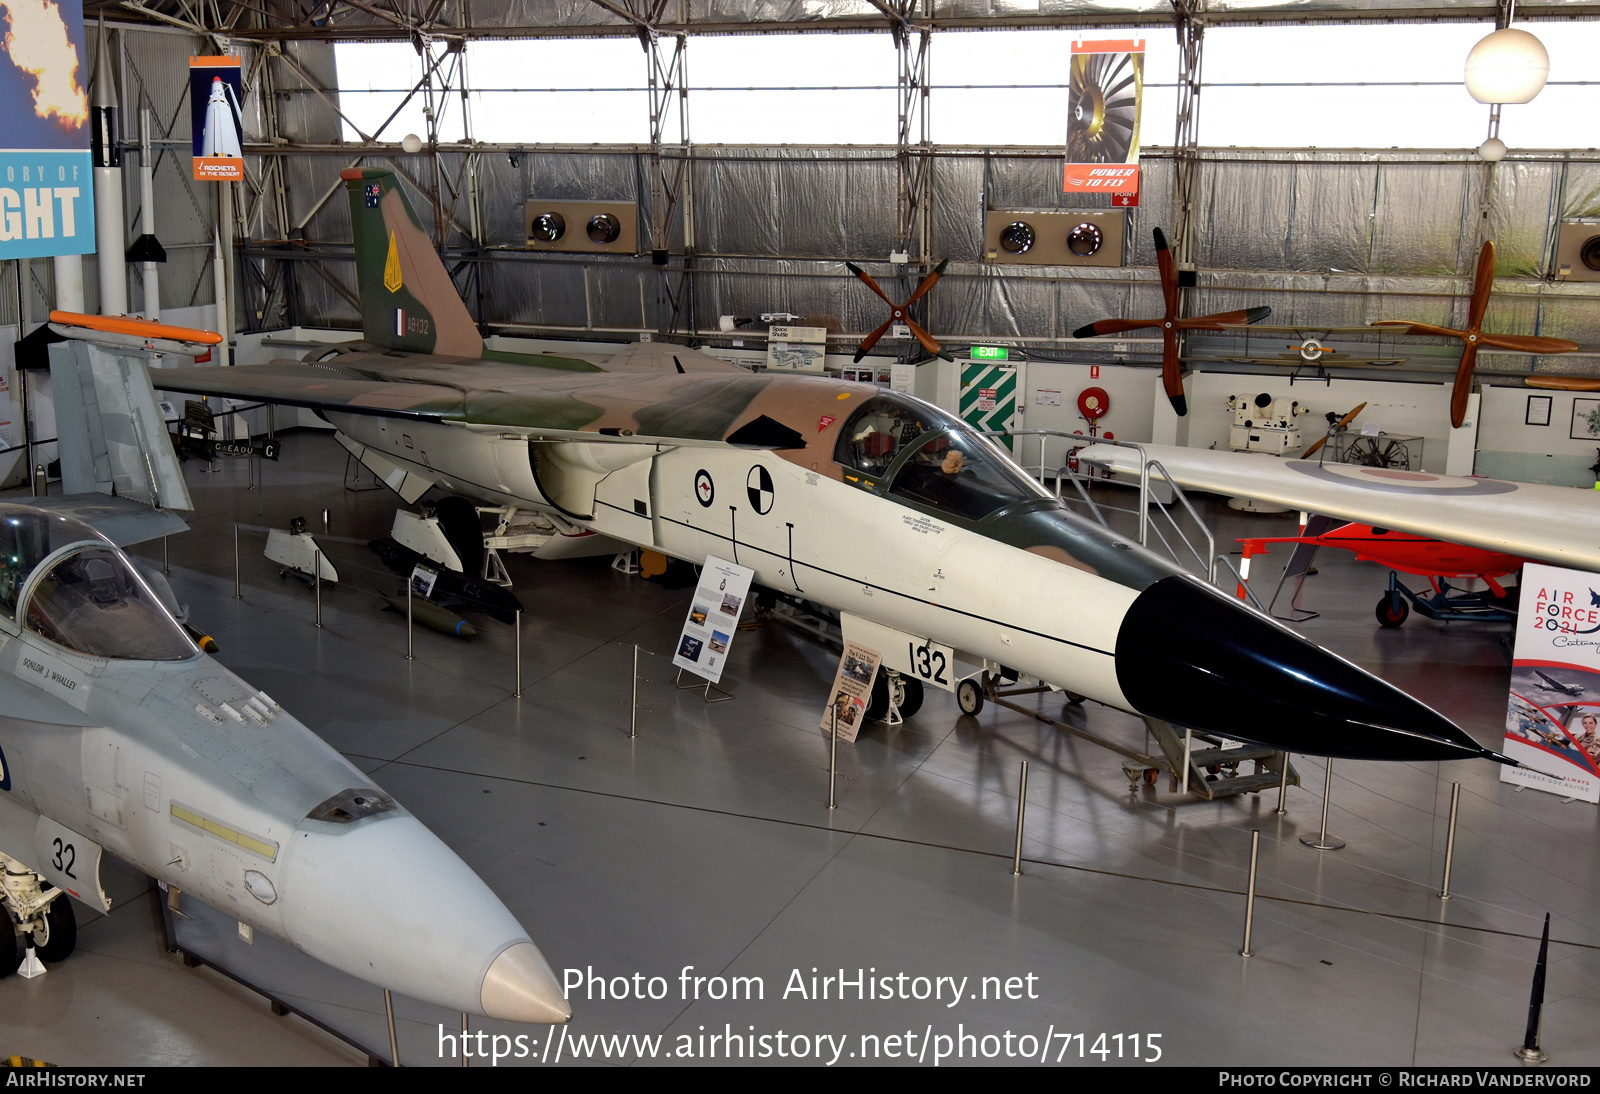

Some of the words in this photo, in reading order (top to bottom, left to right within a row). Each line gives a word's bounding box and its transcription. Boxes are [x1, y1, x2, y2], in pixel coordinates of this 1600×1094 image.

[58, 165, 78, 181] OF
[1089, 168, 1135, 176] POWER
[980, 347, 998, 357] EXIT
[265, 445, 273, 457] G
[1537, 587, 1574, 604] AIR
[1536, 602, 1598, 624] FORCE
[1533, 616, 1578, 635] 2021
[909, 641, 948, 686] 132
[51, 671, 78, 691] WHALLEY
[1511, 770, 1590, 793] AIRFORCE.GOV.AU/100
[1562, 775, 1590, 786] ALWAYS
[52, 837, 77, 880] 32
